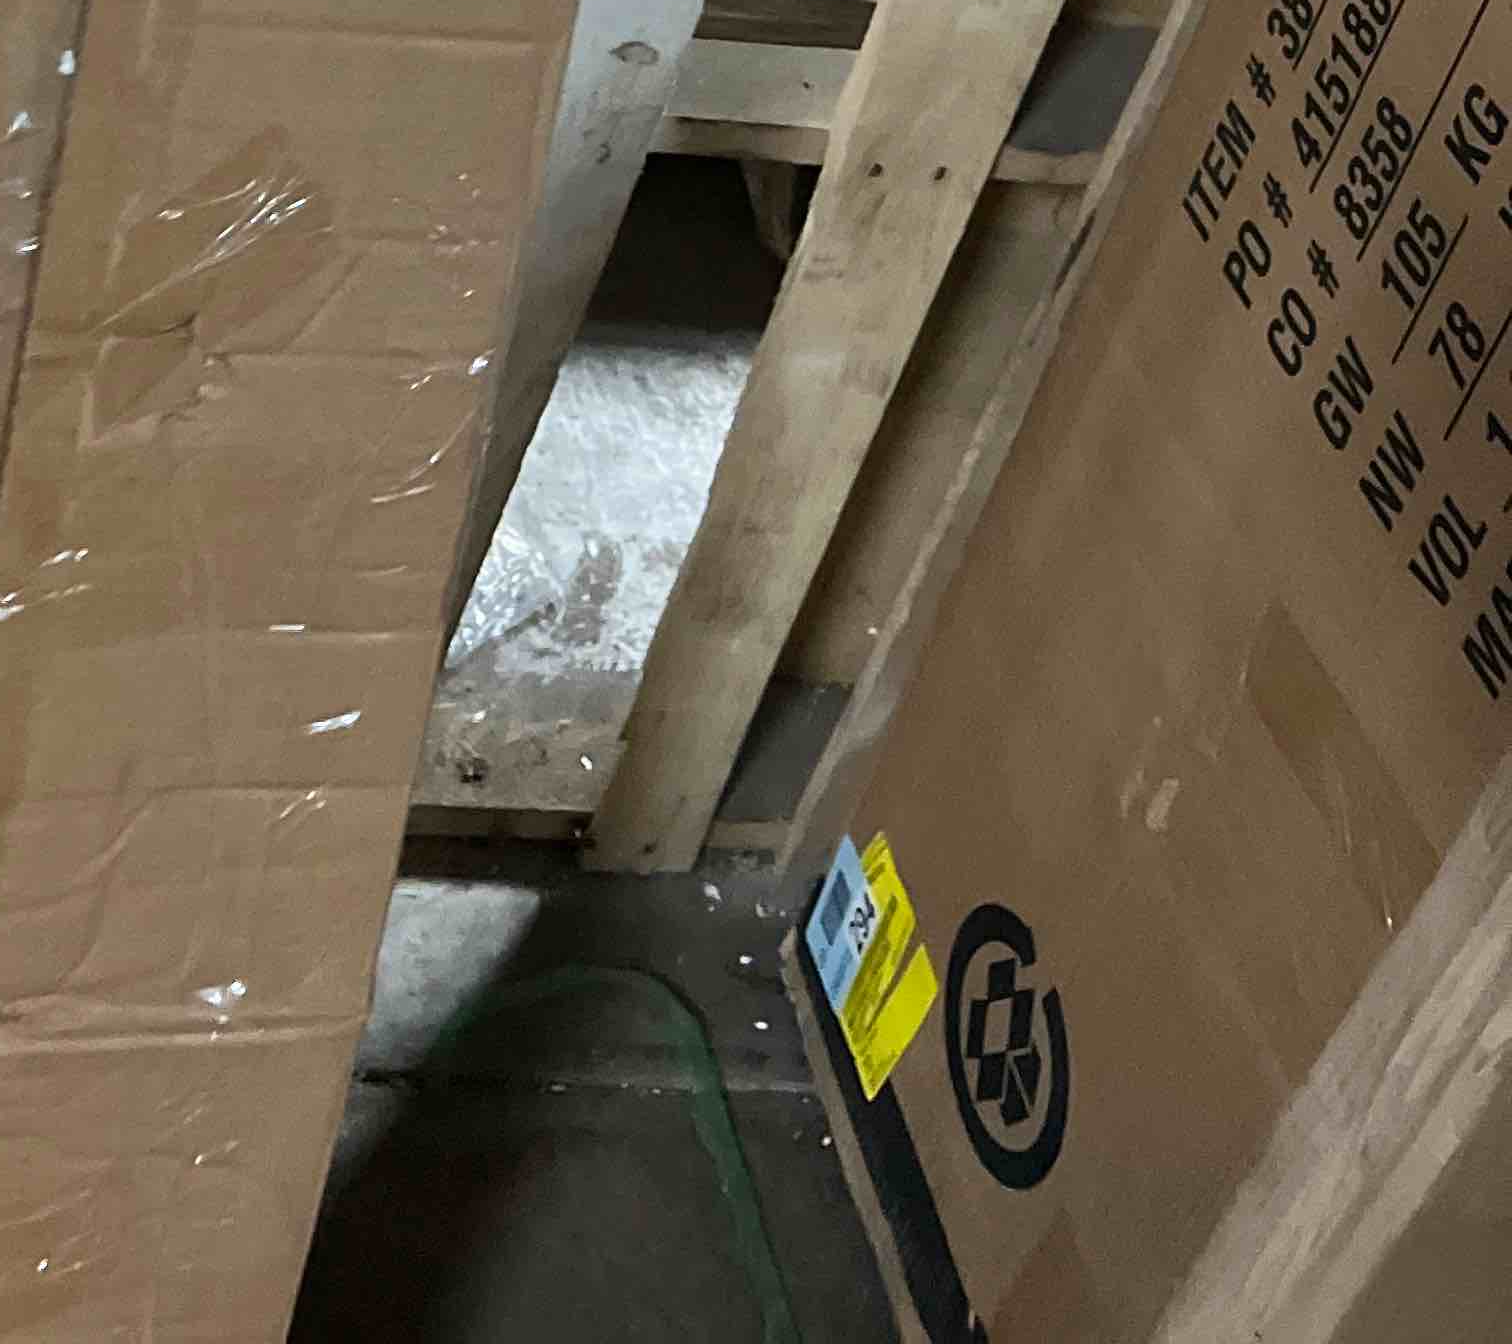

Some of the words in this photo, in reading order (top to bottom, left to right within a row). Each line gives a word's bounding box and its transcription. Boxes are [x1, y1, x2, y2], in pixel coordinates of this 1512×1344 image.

[1182, 98, 1256, 243] ITEM
[1245, 52, 1277, 108] #
[1223, 219, 1272, 311] PO
[1262, 171, 1293, 229] #
[1267, 287, 1317, 377] CO
[1306, 239, 1340, 300] #
[1333, 96, 1413, 241] 8358
[1313, 335, 1374, 451] GW
[1381, 197, 1447, 311] 105
[1444, 83, 1510, 186] KG
[1358, 409, 1425, 534] NW
[1428, 301, 1486, 391] 78
[1407, 493, 1488, 607] VOL
